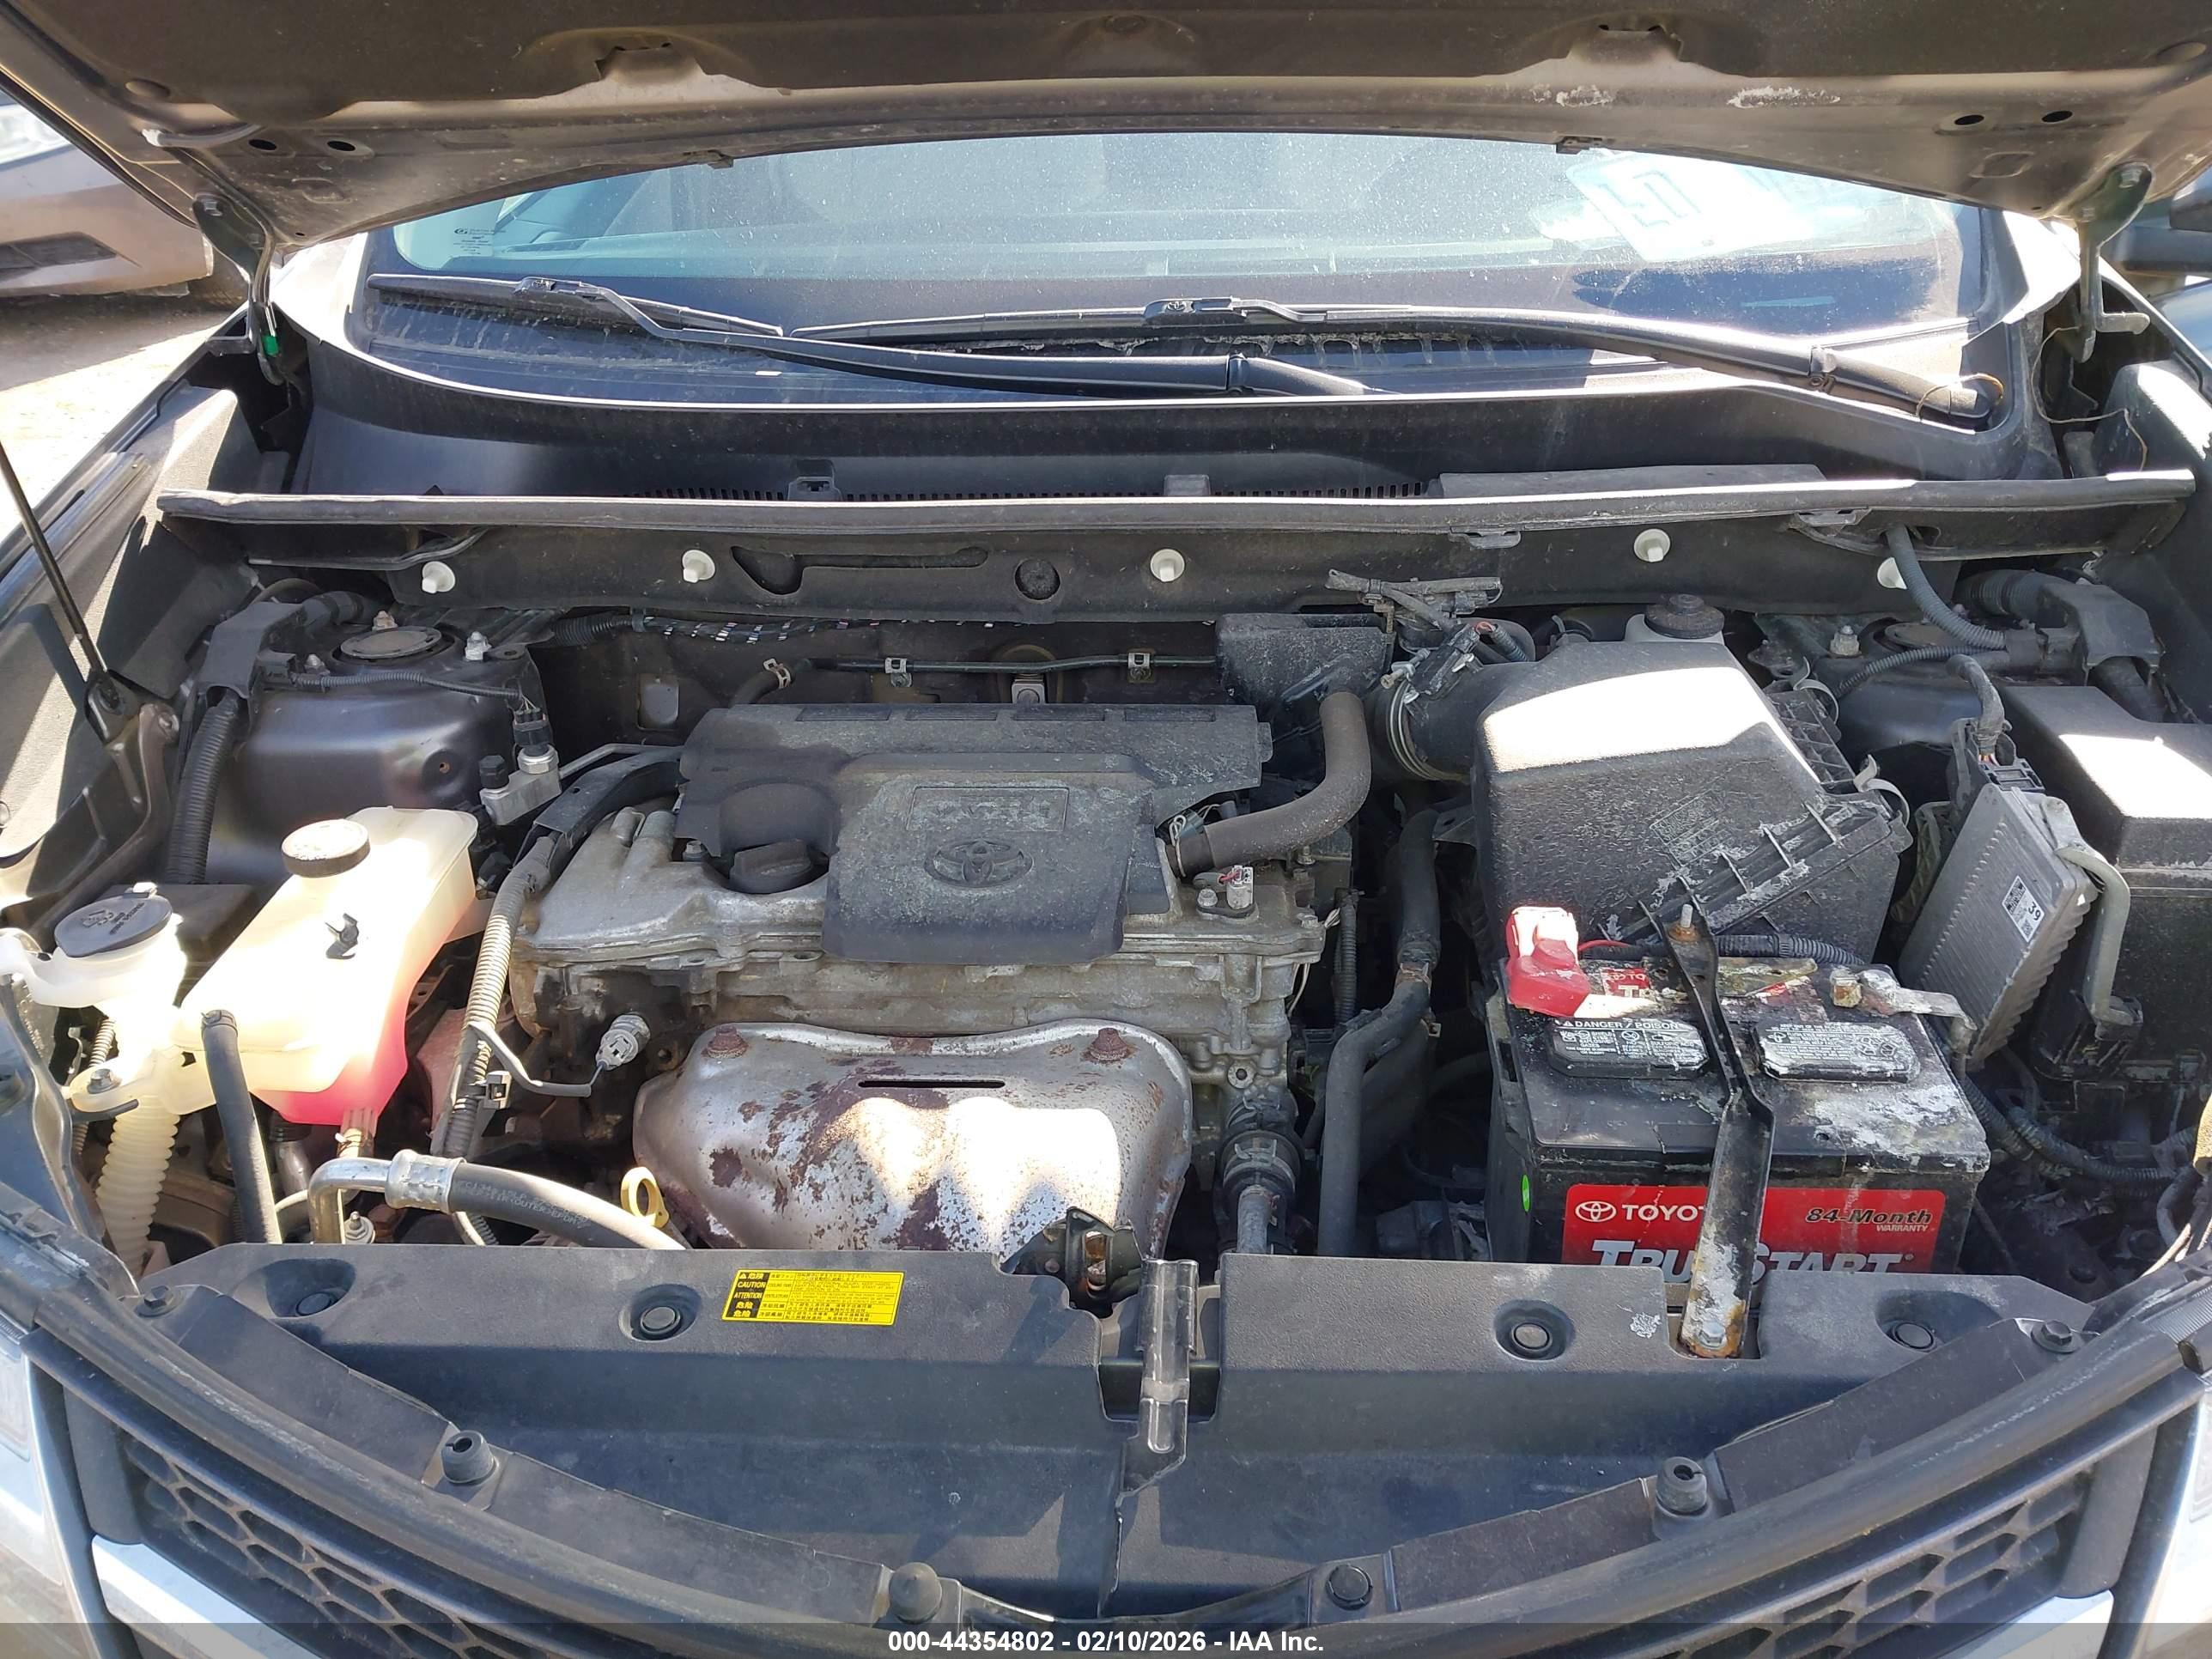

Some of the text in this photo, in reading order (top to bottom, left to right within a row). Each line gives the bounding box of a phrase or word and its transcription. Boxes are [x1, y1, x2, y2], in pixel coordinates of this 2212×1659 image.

[2027, 901, 2041, 921] 39
[1575, 1020, 1623, 1029] DANGER
[1621, 1204, 1705, 1221] TOYO
[1806, 1206, 1933, 1224] 84-Month
